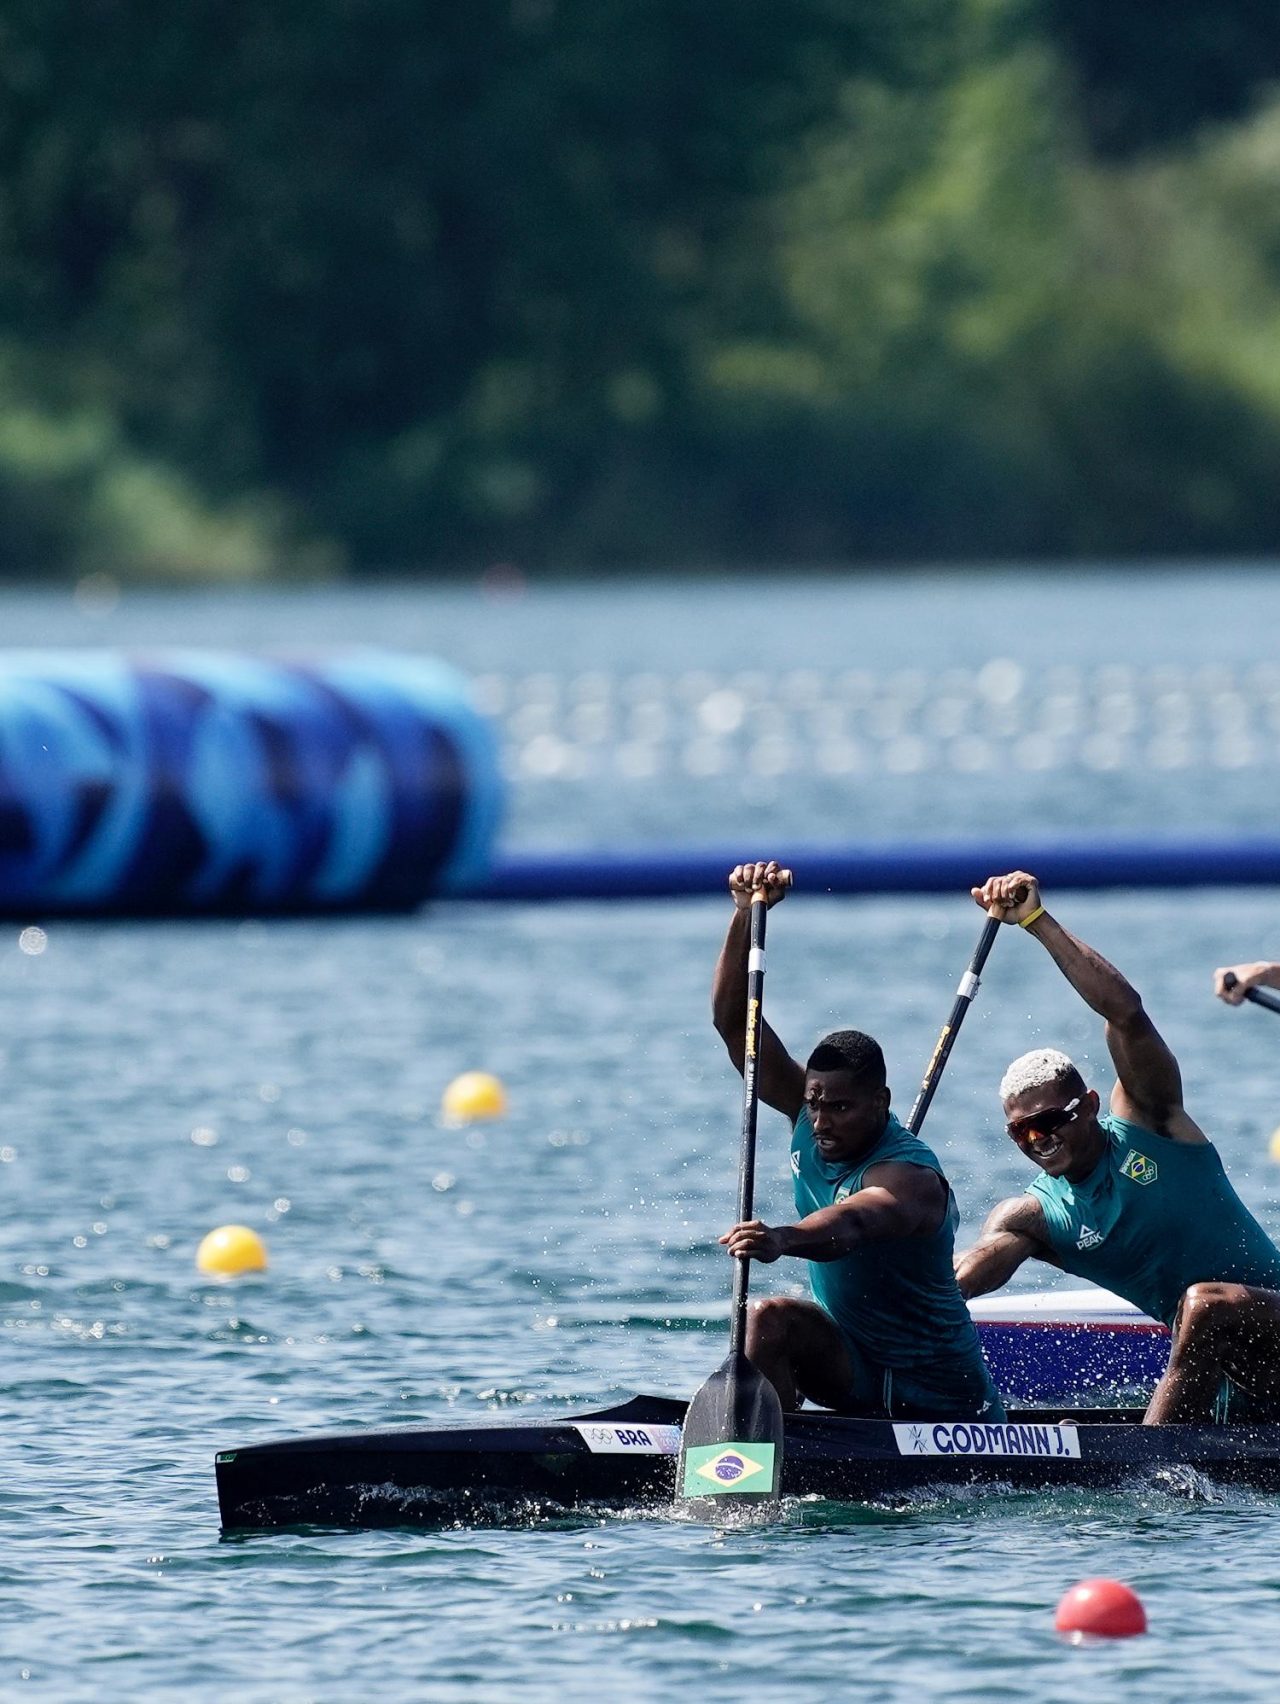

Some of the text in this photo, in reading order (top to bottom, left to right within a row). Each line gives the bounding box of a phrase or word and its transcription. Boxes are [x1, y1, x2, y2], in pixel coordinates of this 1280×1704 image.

[1076, 1230, 1104, 1250] PEAK
[614, 1429, 652, 1447] BRA
[932, 1424, 1070, 1456] GODMANN J.
